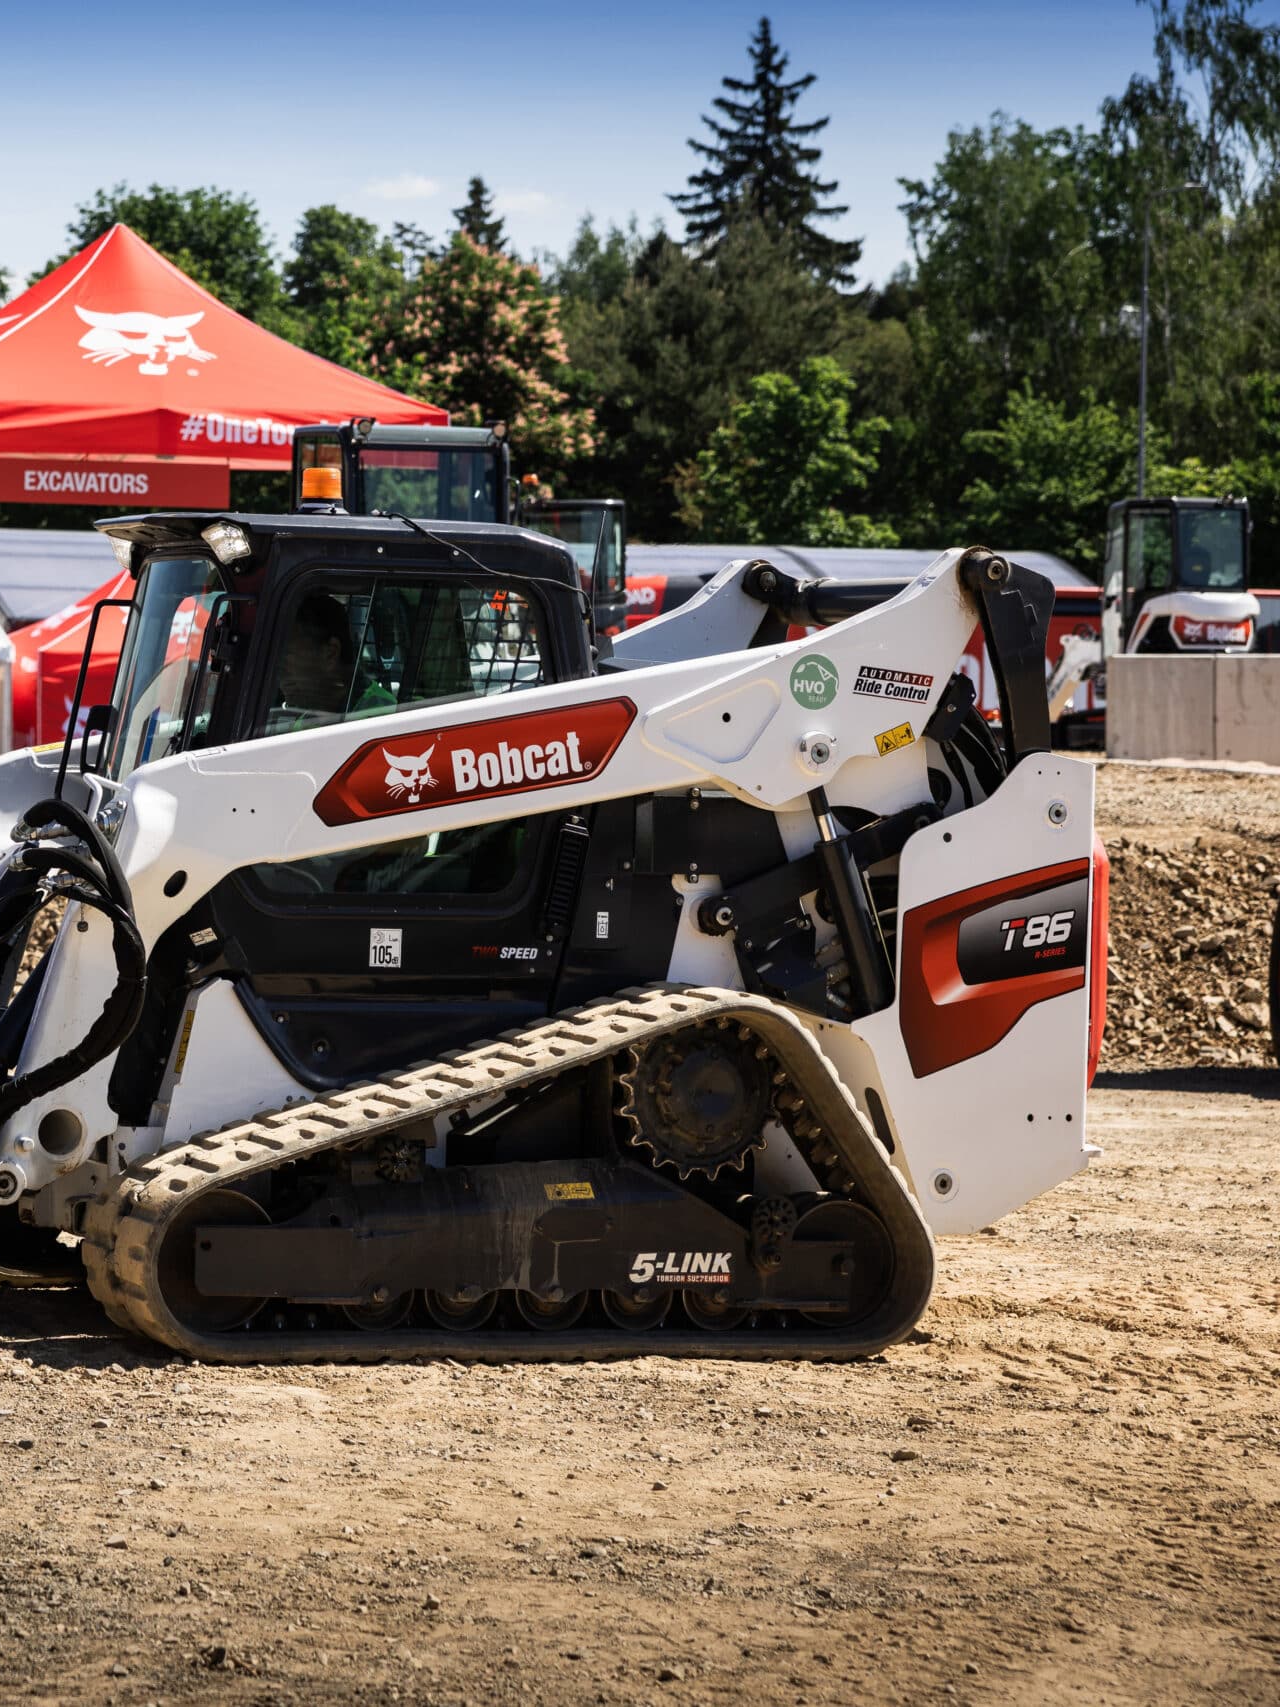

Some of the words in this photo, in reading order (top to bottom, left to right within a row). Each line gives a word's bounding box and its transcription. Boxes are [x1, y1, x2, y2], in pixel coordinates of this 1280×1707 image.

[23, 469, 149, 495] EXCAVATORS
[793, 679, 825, 695] HVO
[860, 667, 931, 687] AUTOMATIC
[854, 678, 882, 695] Ride
[884, 682, 931, 702] Control
[451, 731, 584, 792] Bobcat
[1001, 910, 1075, 951] T86
[372, 945, 392, 964] 105
[500, 946, 538, 959] SPEED
[1034, 946, 1067, 959] R-SERIES
[629, 1252, 732, 1283] 5-LINK
[656, 1274, 686, 1283] TORSION
